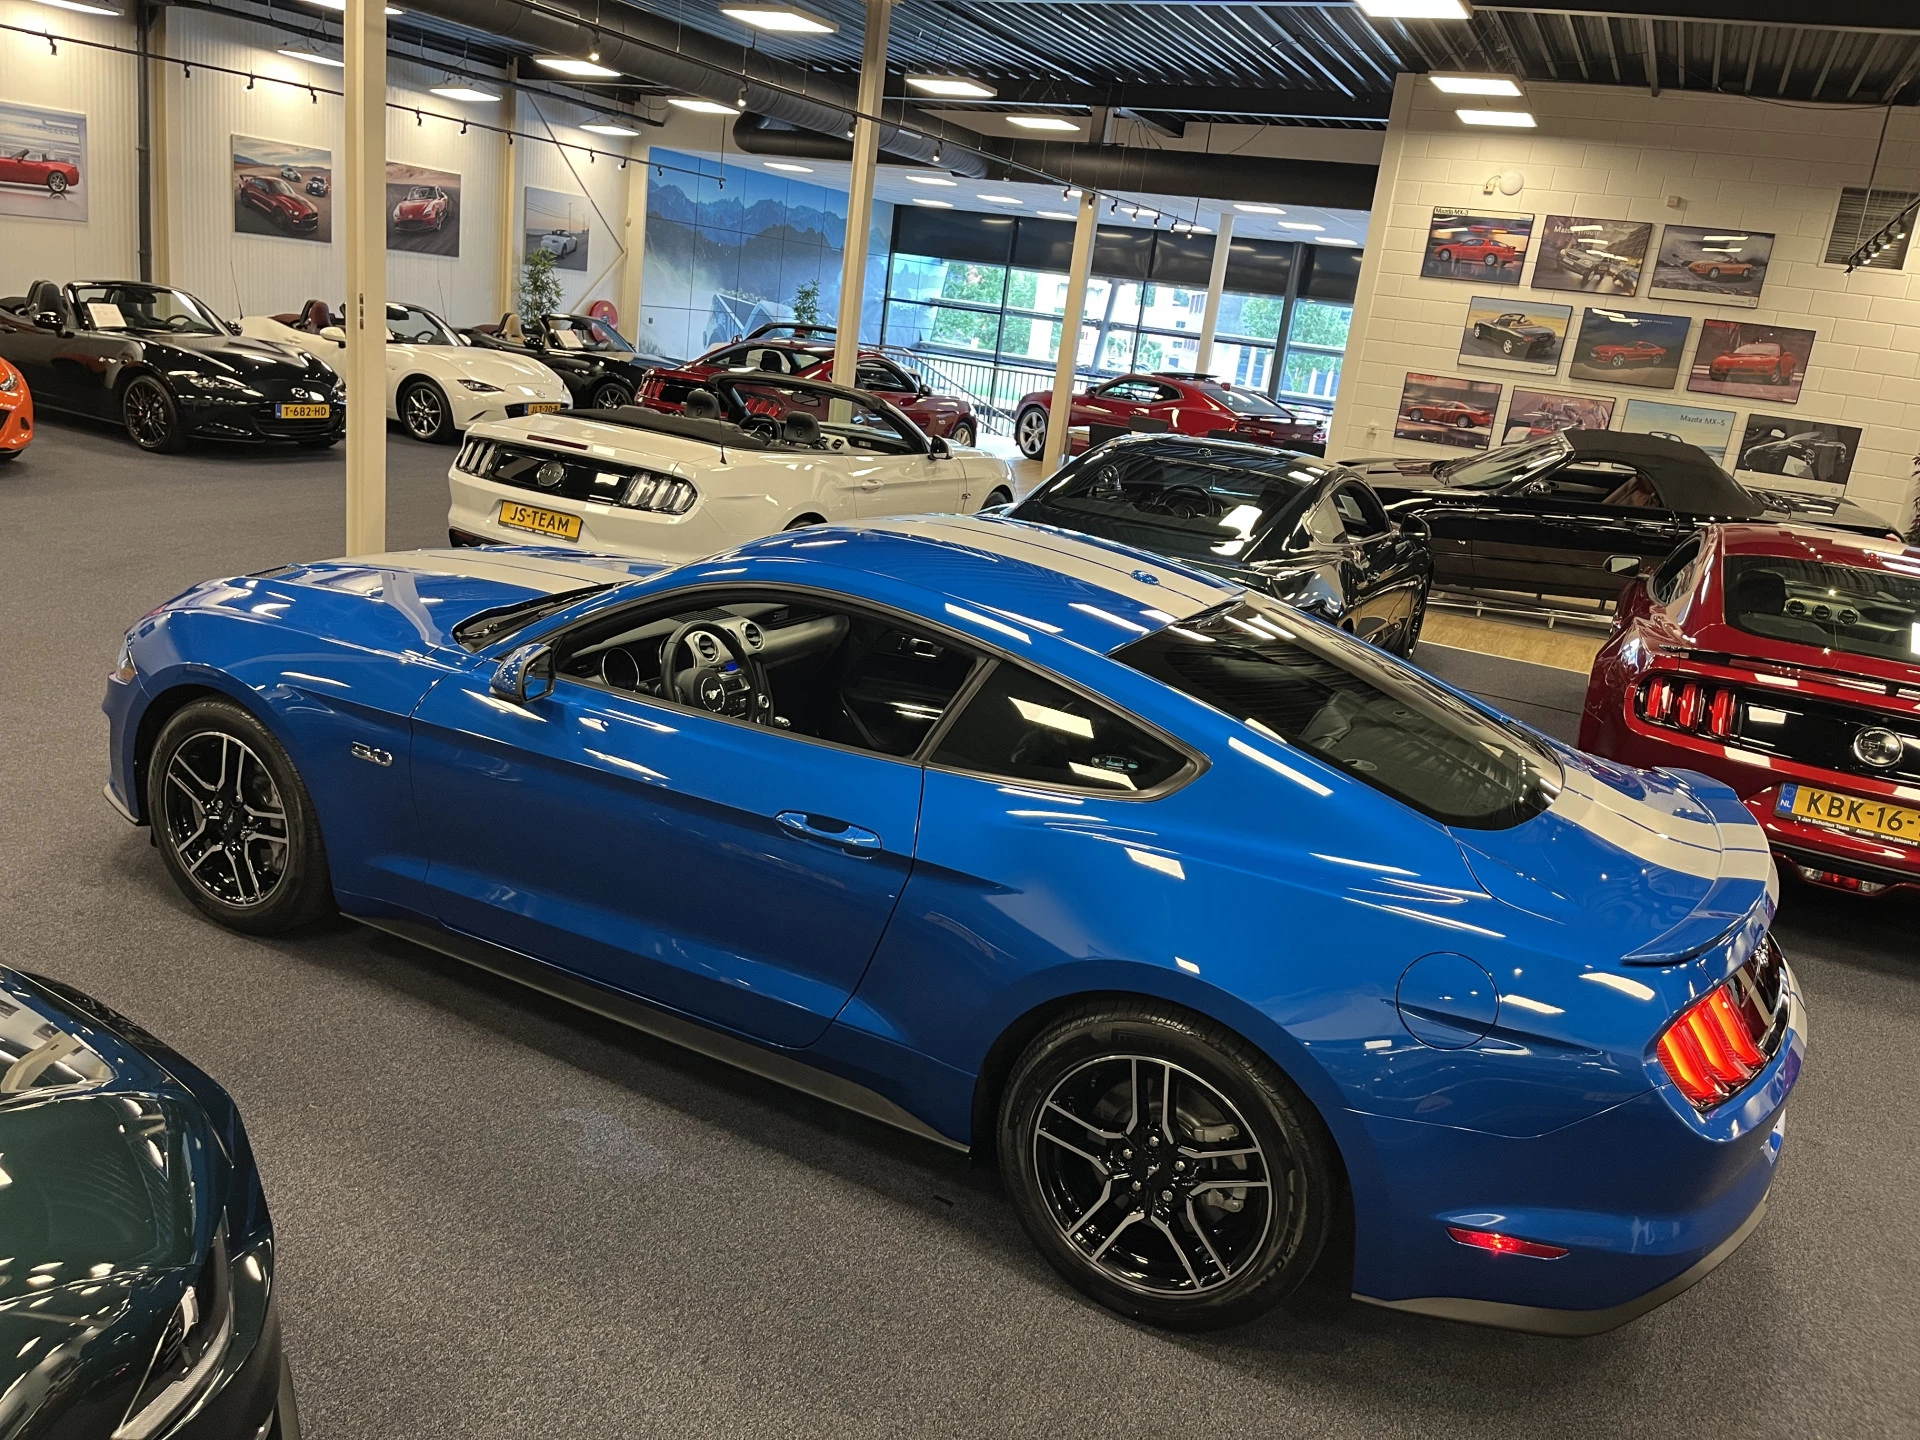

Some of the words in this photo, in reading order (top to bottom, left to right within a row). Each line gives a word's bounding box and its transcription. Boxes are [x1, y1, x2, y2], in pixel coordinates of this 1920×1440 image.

[284, 406, 327, 417] T-682-HD
[1680, 414, 1703, 424] Mazda
[1704, 417, 1726, 427] MX-5
[509, 506, 570, 533] JS-TEAM
[1780, 799, 1792, 808] NL
[1806, 791, 1920, 837] KBK-16-
